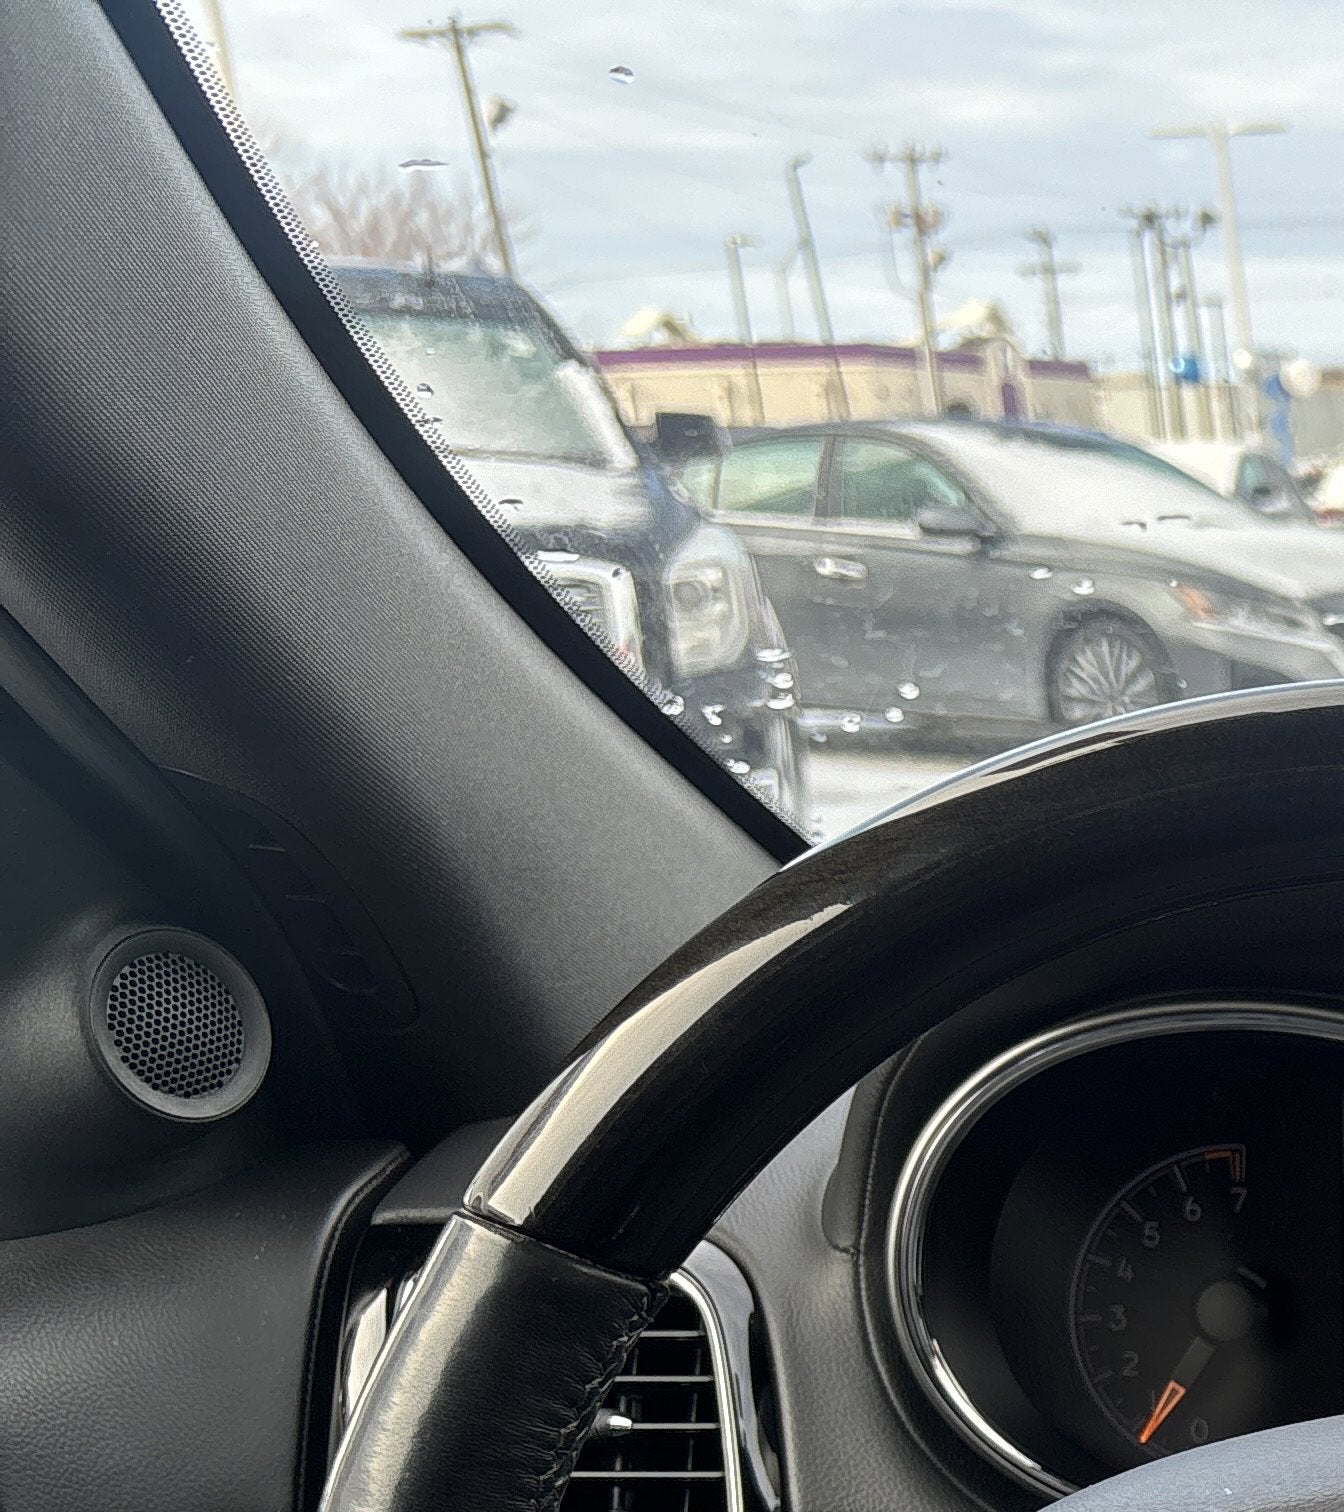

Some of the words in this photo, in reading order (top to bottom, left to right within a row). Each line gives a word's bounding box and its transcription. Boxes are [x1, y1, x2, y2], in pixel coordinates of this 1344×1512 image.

[1184, 1197, 1202, 1222] 6
[1143, 1221, 1160, 1249] 5
[1117, 1257, 1135, 1282] 4
[1111, 1304, 1127, 1331] 3
[1122, 1351, 1139, 1376] 2
